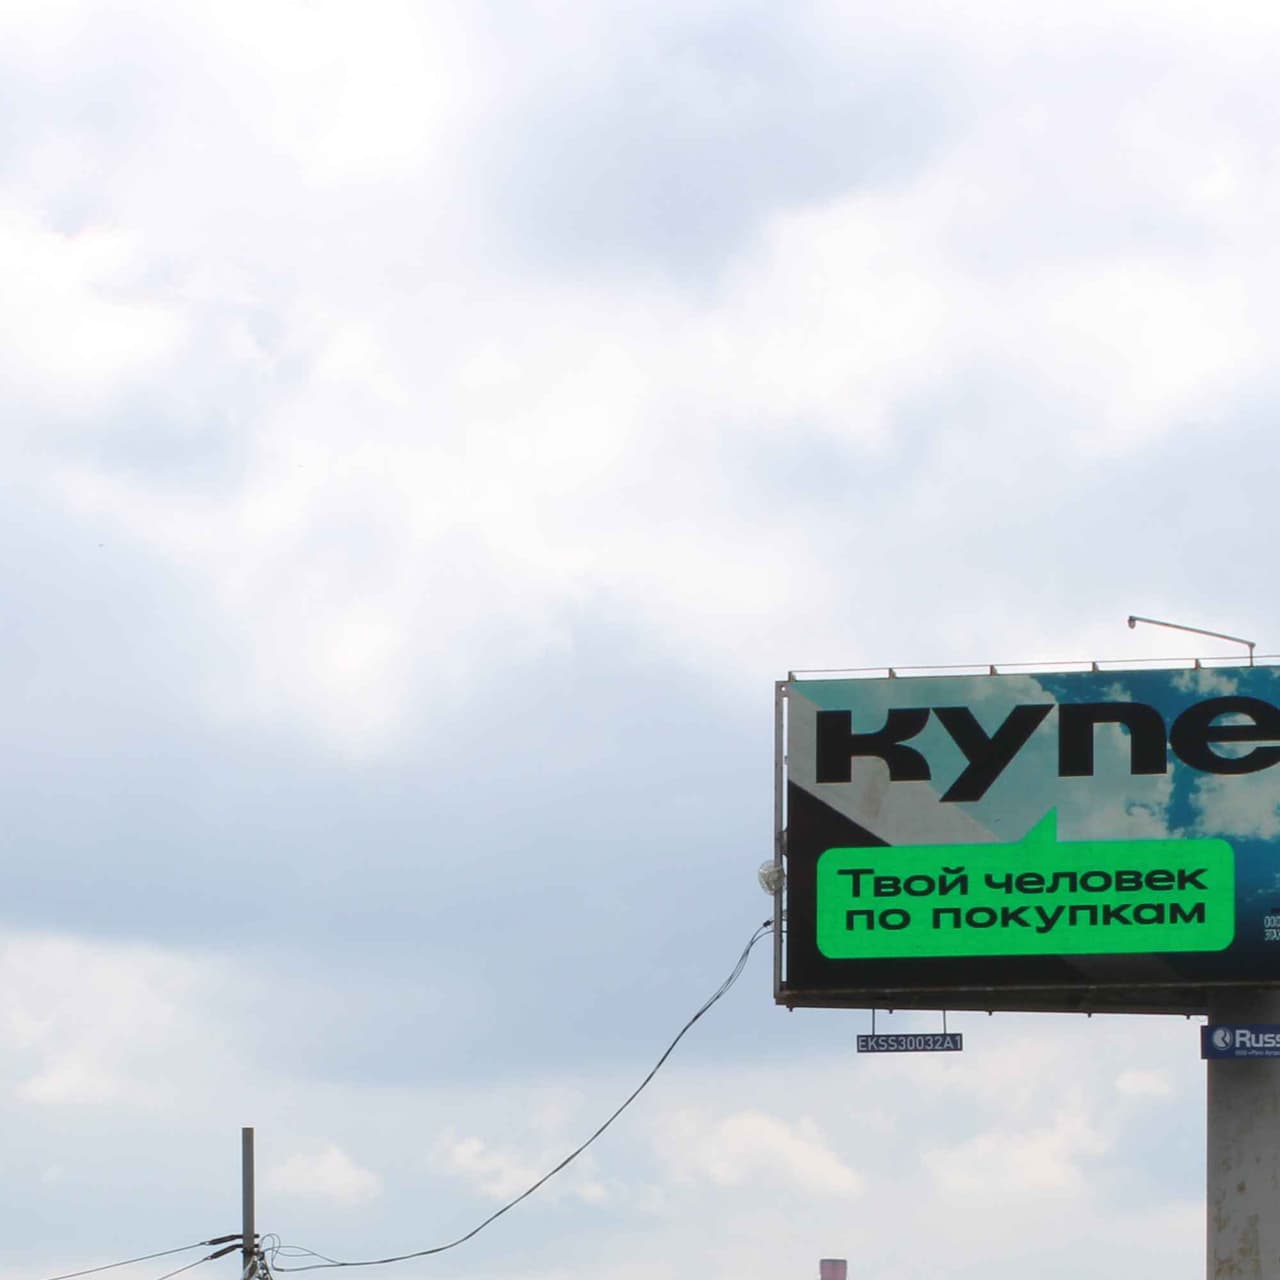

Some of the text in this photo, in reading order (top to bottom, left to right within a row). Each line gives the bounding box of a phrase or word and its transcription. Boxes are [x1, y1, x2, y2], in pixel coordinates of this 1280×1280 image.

[837, 865, 1208, 897] Твой человек
[846, 901, 1206, 934] по покупкам
[858, 1035, 961, 1051] EKSS30032A1
